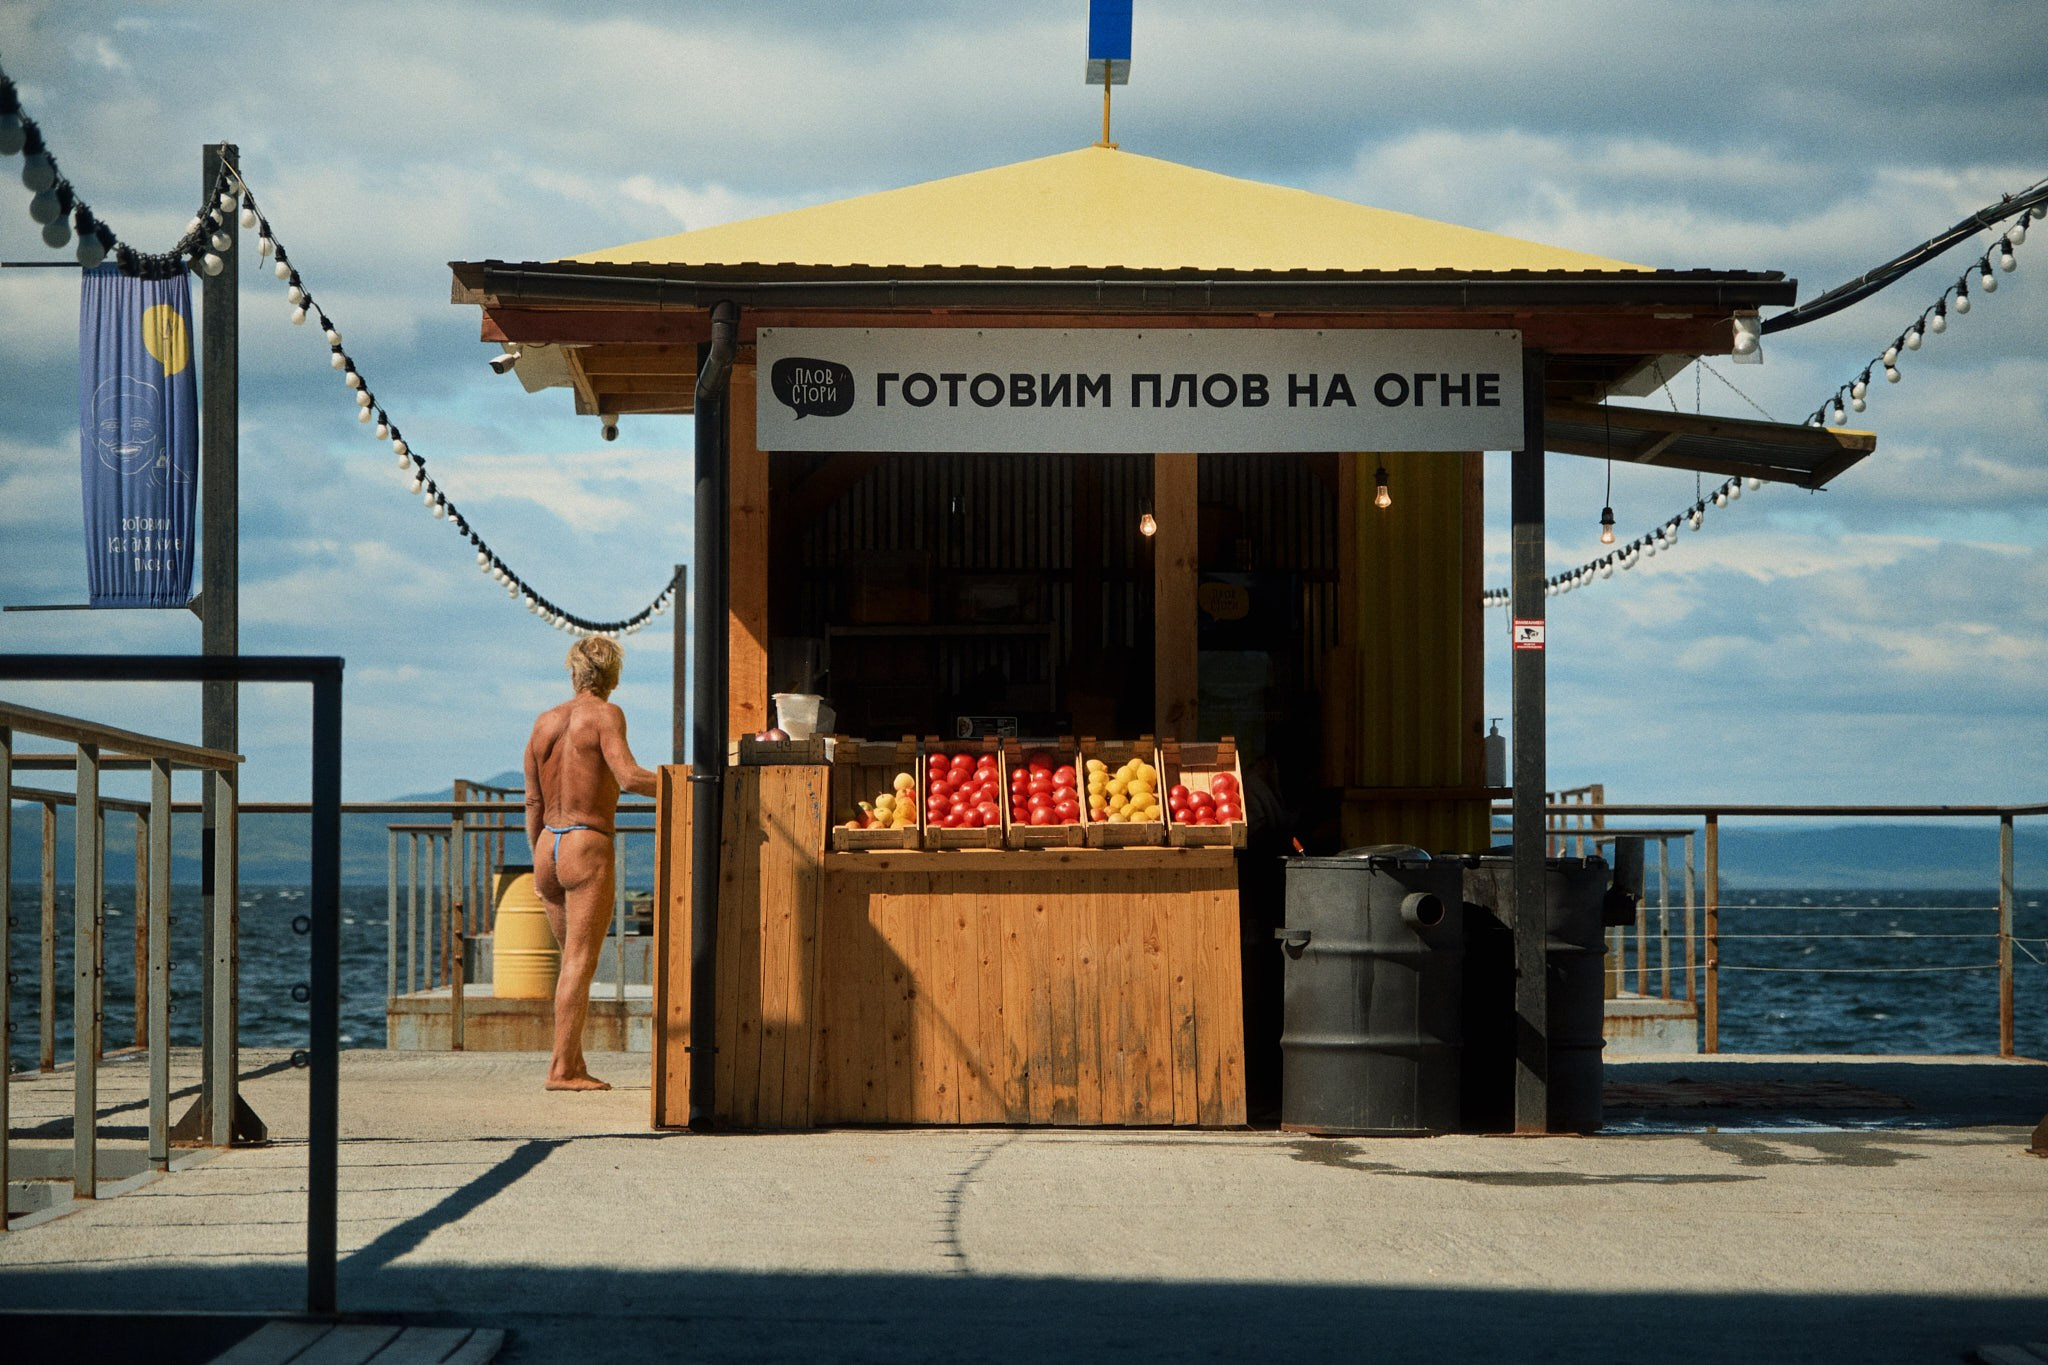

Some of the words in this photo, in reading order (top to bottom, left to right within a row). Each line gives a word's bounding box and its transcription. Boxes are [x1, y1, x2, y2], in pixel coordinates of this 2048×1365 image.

[795, 368, 834, 385] ПЛОВ
[792, 384, 837, 404] СТОРИ
[877, 373, 1111, 408] ГОТОВИМ
[1131, 373, 1270, 408] ПЛОВ
[1288, 373, 1357, 408] НА
[1374, 373, 1501, 408] ОГНЕ
